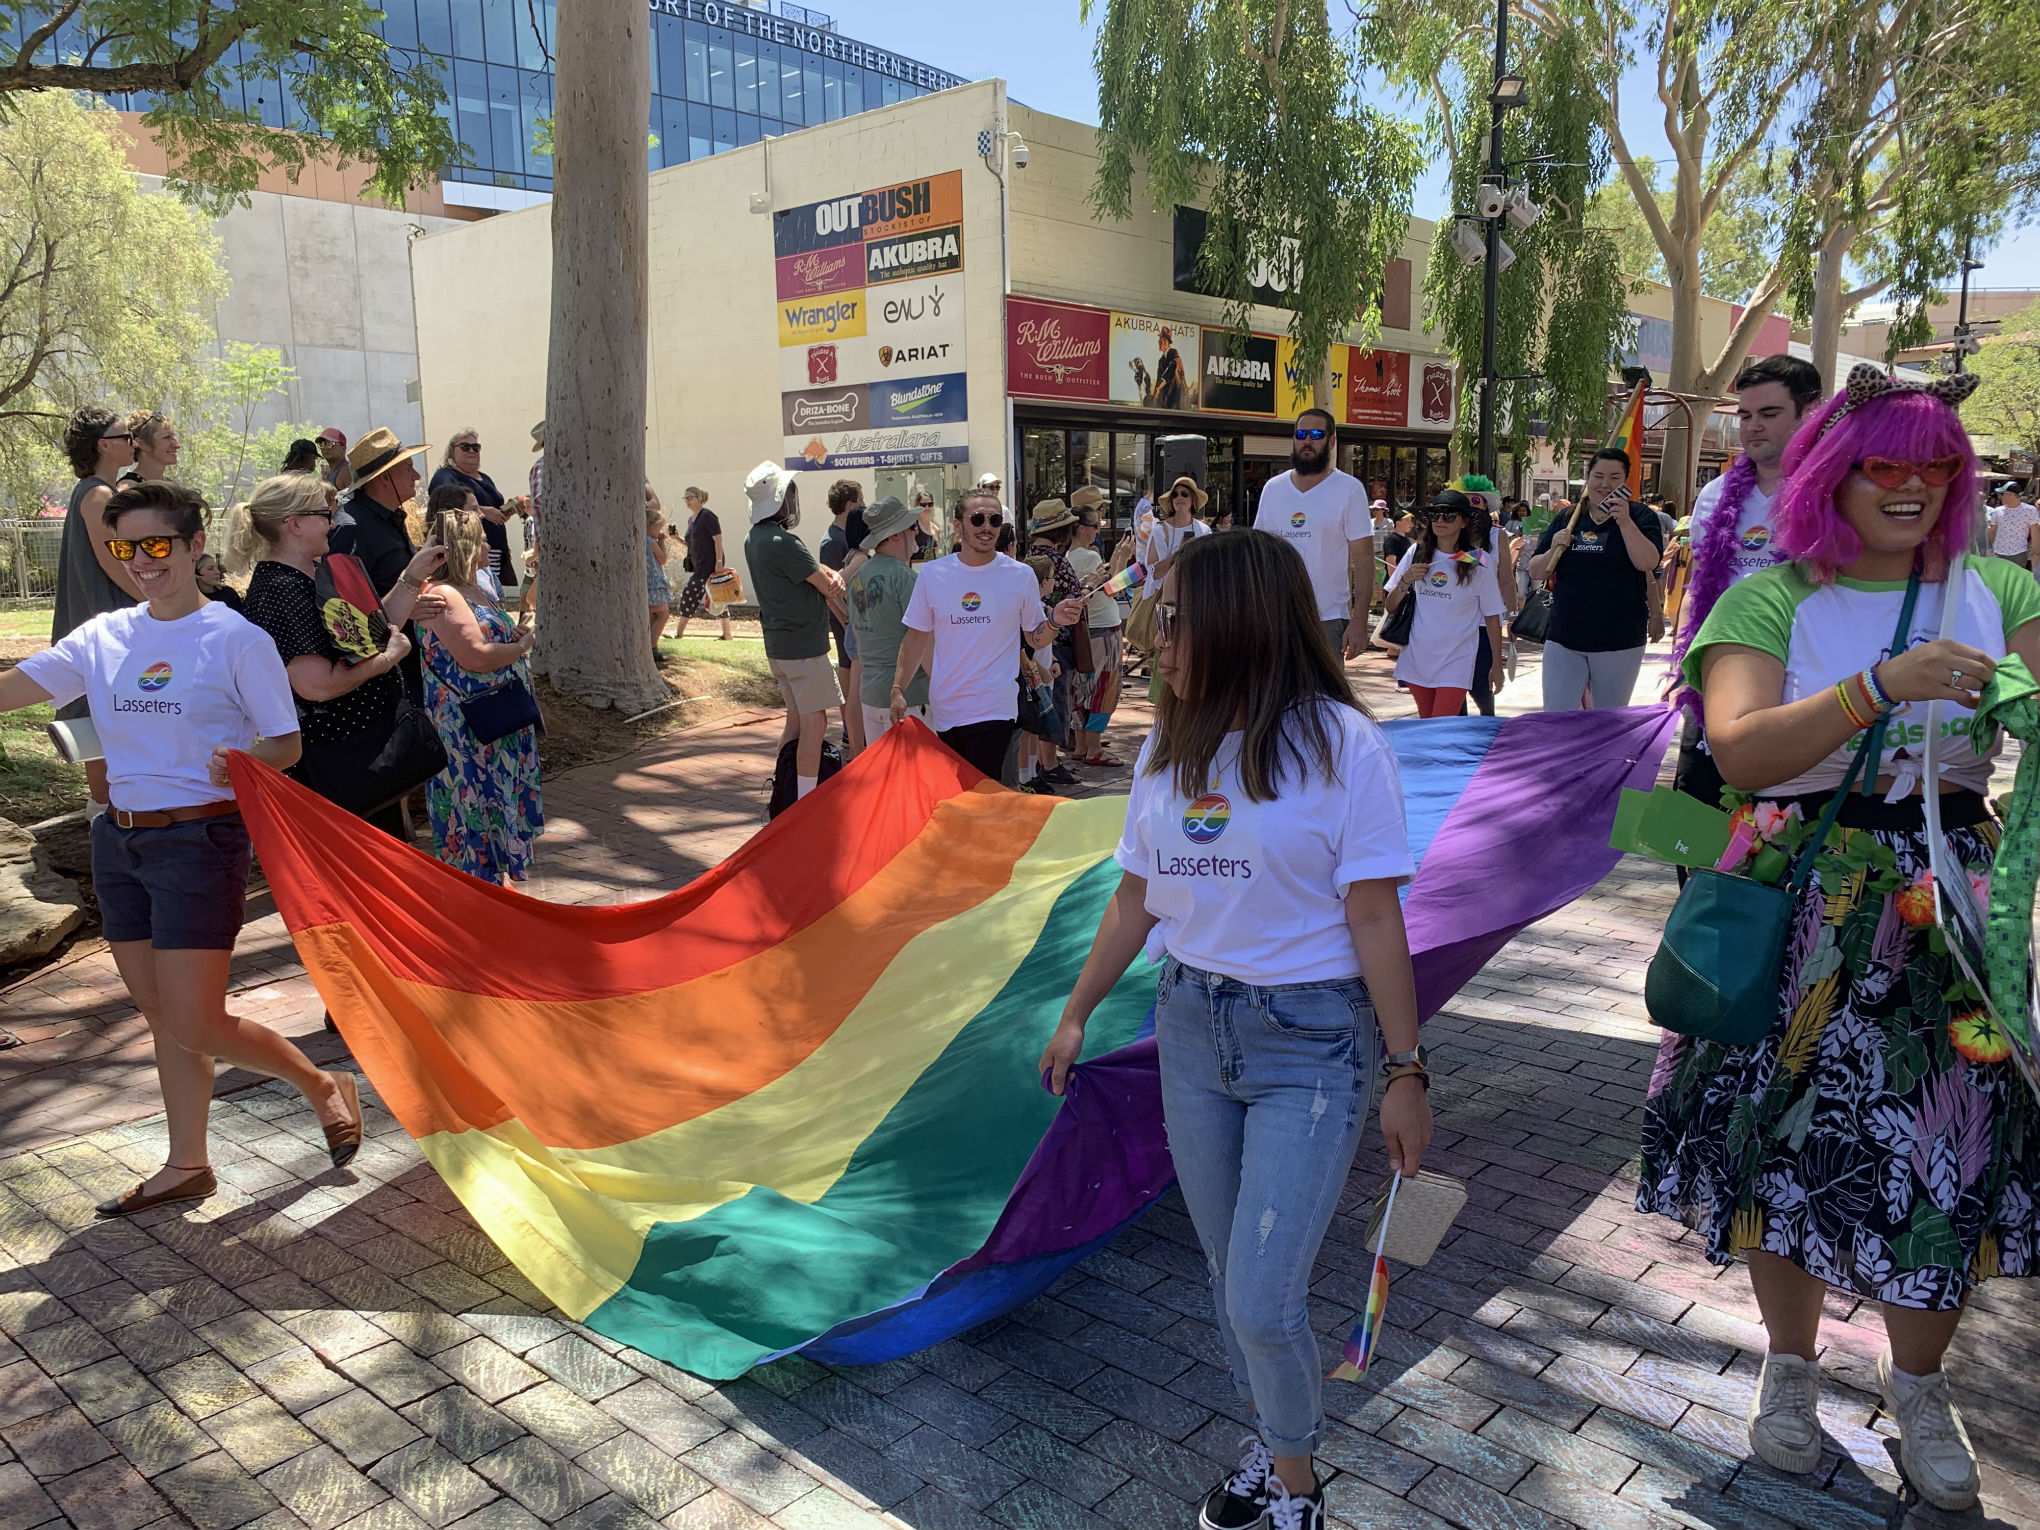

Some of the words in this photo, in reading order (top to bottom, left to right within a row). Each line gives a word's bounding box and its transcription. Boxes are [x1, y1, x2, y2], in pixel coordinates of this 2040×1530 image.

[705, 2, 734, 28] OF
[743, 12, 785, 44] THE
[793, 26, 900, 78] NORTHERN
[869, 234, 959, 271] AKUBRA
[805, 256, 846, 281] Williams
[785, 301, 858, 332] Wrangler
[1114, 316, 1161, 334] AKUBRA
[1169, 323, 1196, 338] HATS
[895, 343, 950, 363] ARIAT
[1036, 336, 1101, 362] Williams
[1207, 355, 1271, 381] AKUBRA
[890, 382, 944, 407] Blundstone
[835, 429, 941, 453] Australiana
[834, 455, 876, 467] SOUVENIRS
[880, 453, 914, 466] T-SHIRTS
[920, 452, 944, 462] GIFTS
[1572, 544, 1604, 552] Lasseters
[950, 614, 992, 625] Lasseters
[114, 694, 182, 715] Lasseters
[1157, 848, 1252, 879] Lasseters
